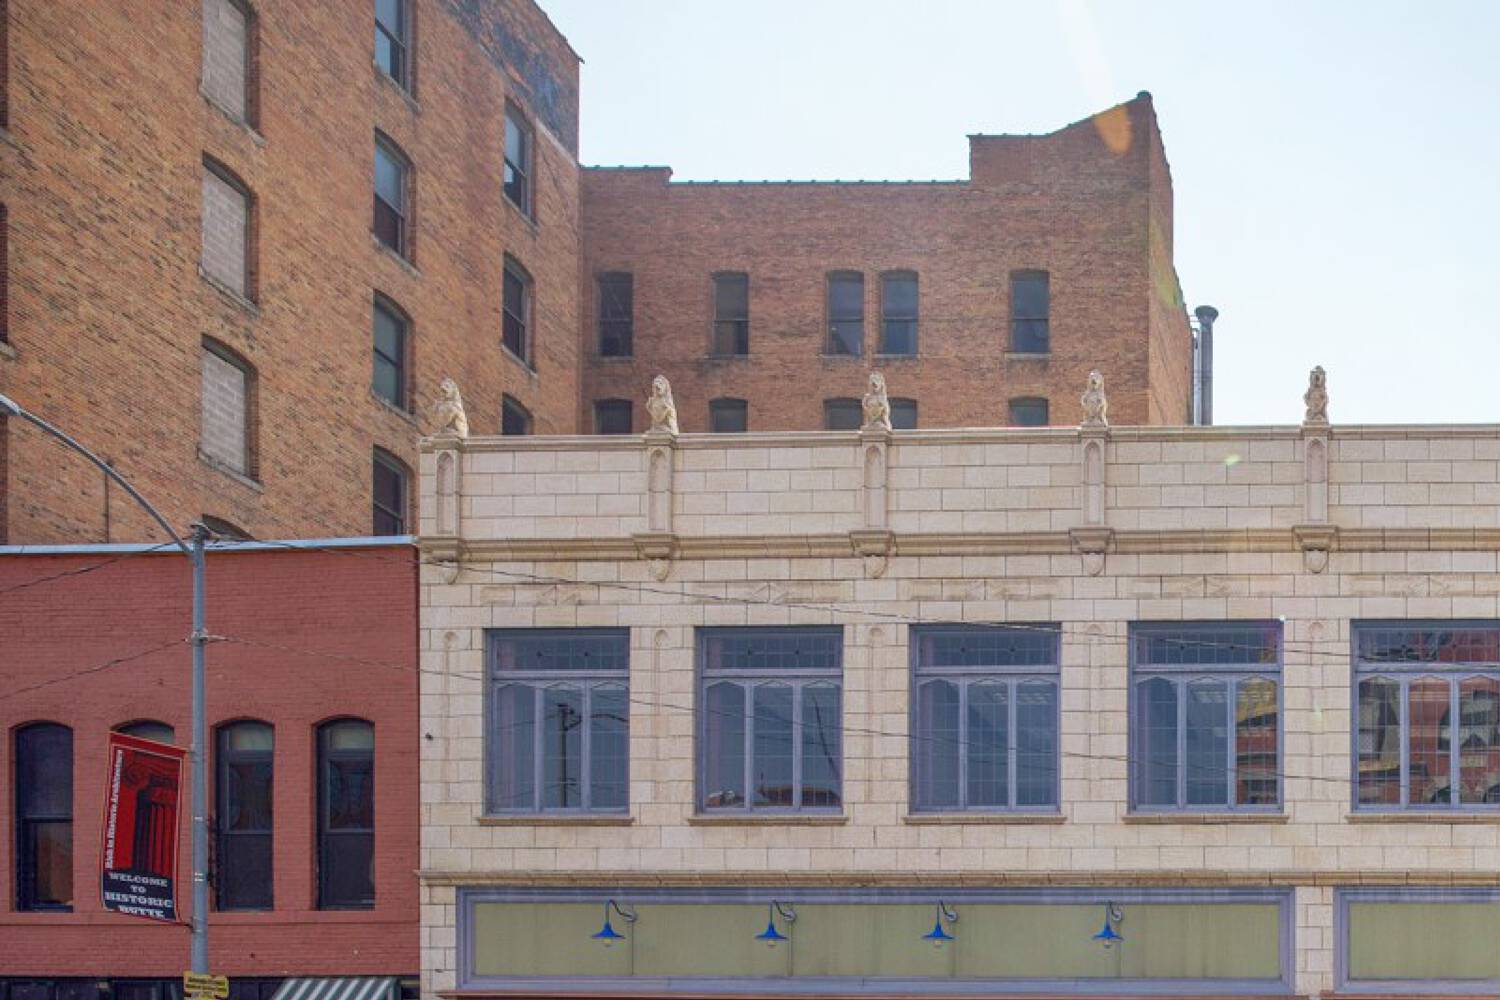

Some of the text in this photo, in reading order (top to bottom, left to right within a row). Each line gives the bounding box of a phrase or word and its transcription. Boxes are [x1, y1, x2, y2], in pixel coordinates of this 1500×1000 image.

[108, 872, 168, 887] WELCOME
[130, 885, 147, 893] TO
[104, 892, 174, 908] HISTORIC
